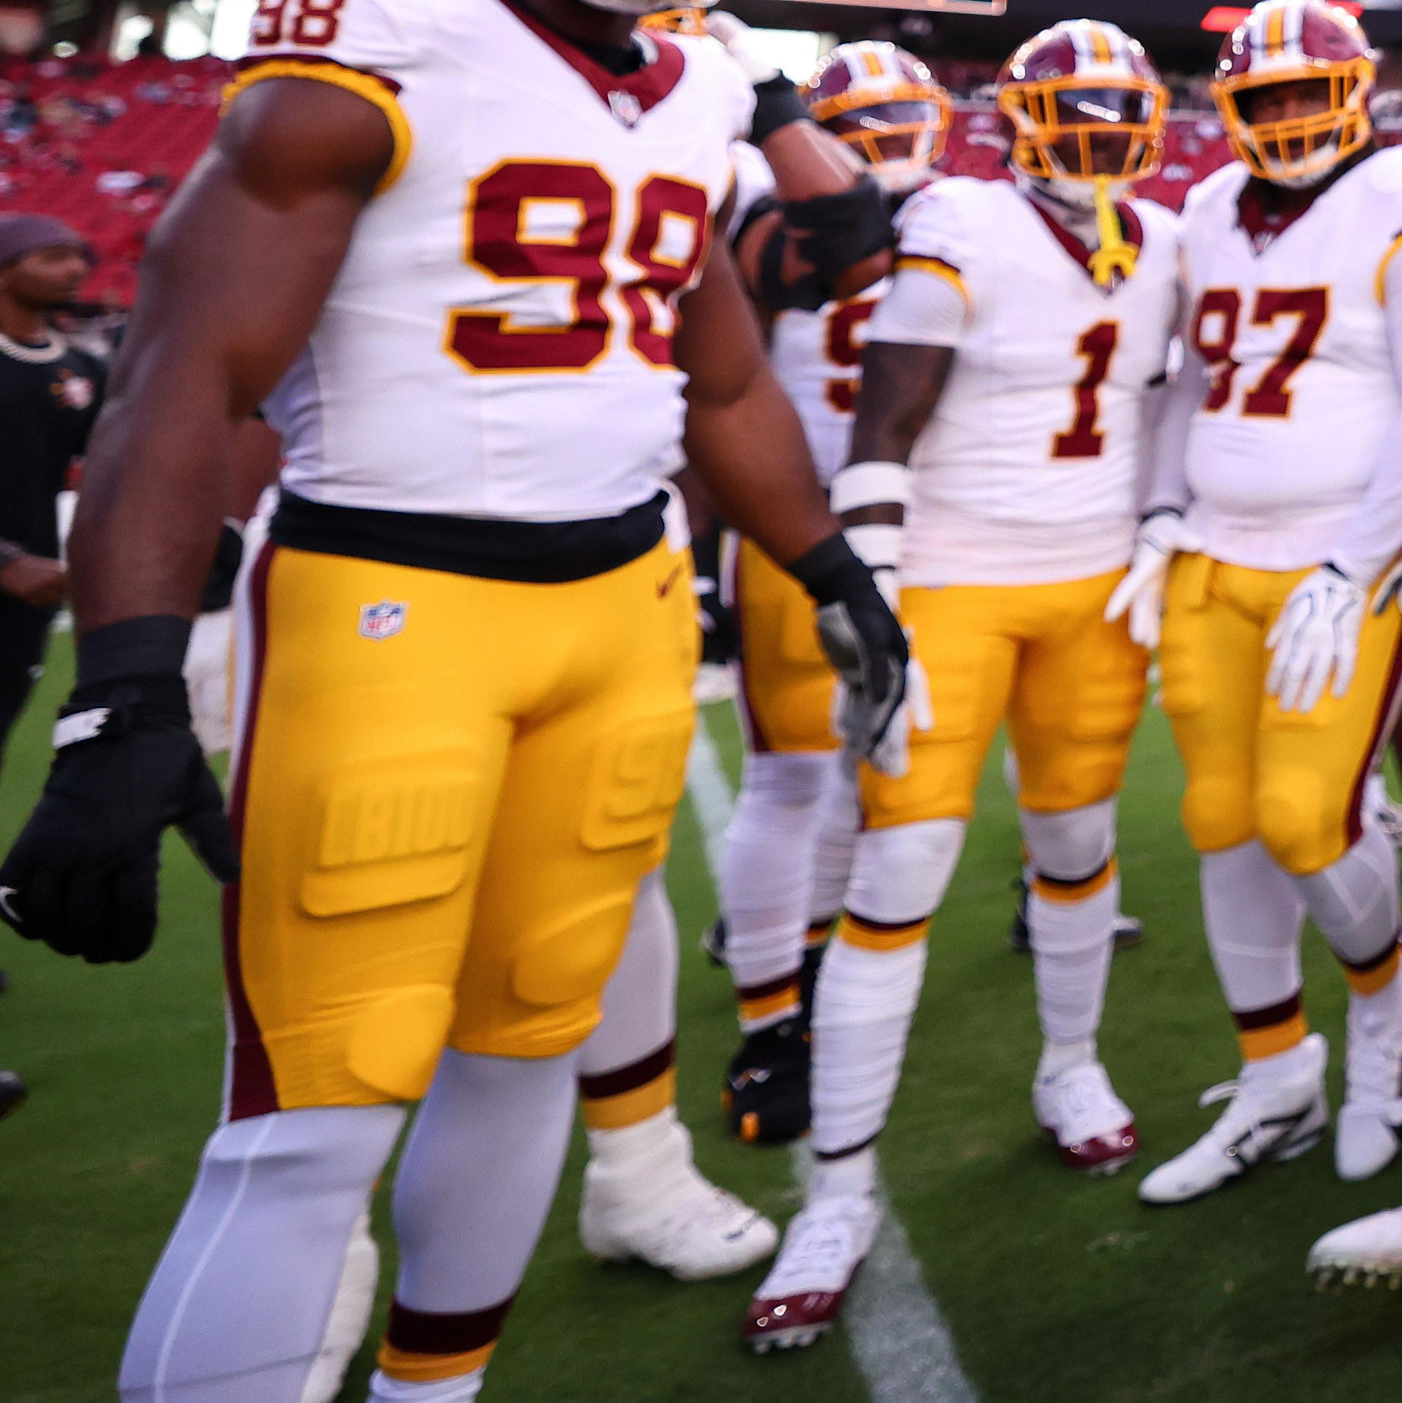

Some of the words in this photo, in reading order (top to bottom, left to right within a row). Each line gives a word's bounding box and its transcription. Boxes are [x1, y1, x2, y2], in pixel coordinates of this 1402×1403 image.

[442, 156, 709, 375] 98
[1050, 320, 1119, 460] 1
[1192, 285, 1331, 419] 97
